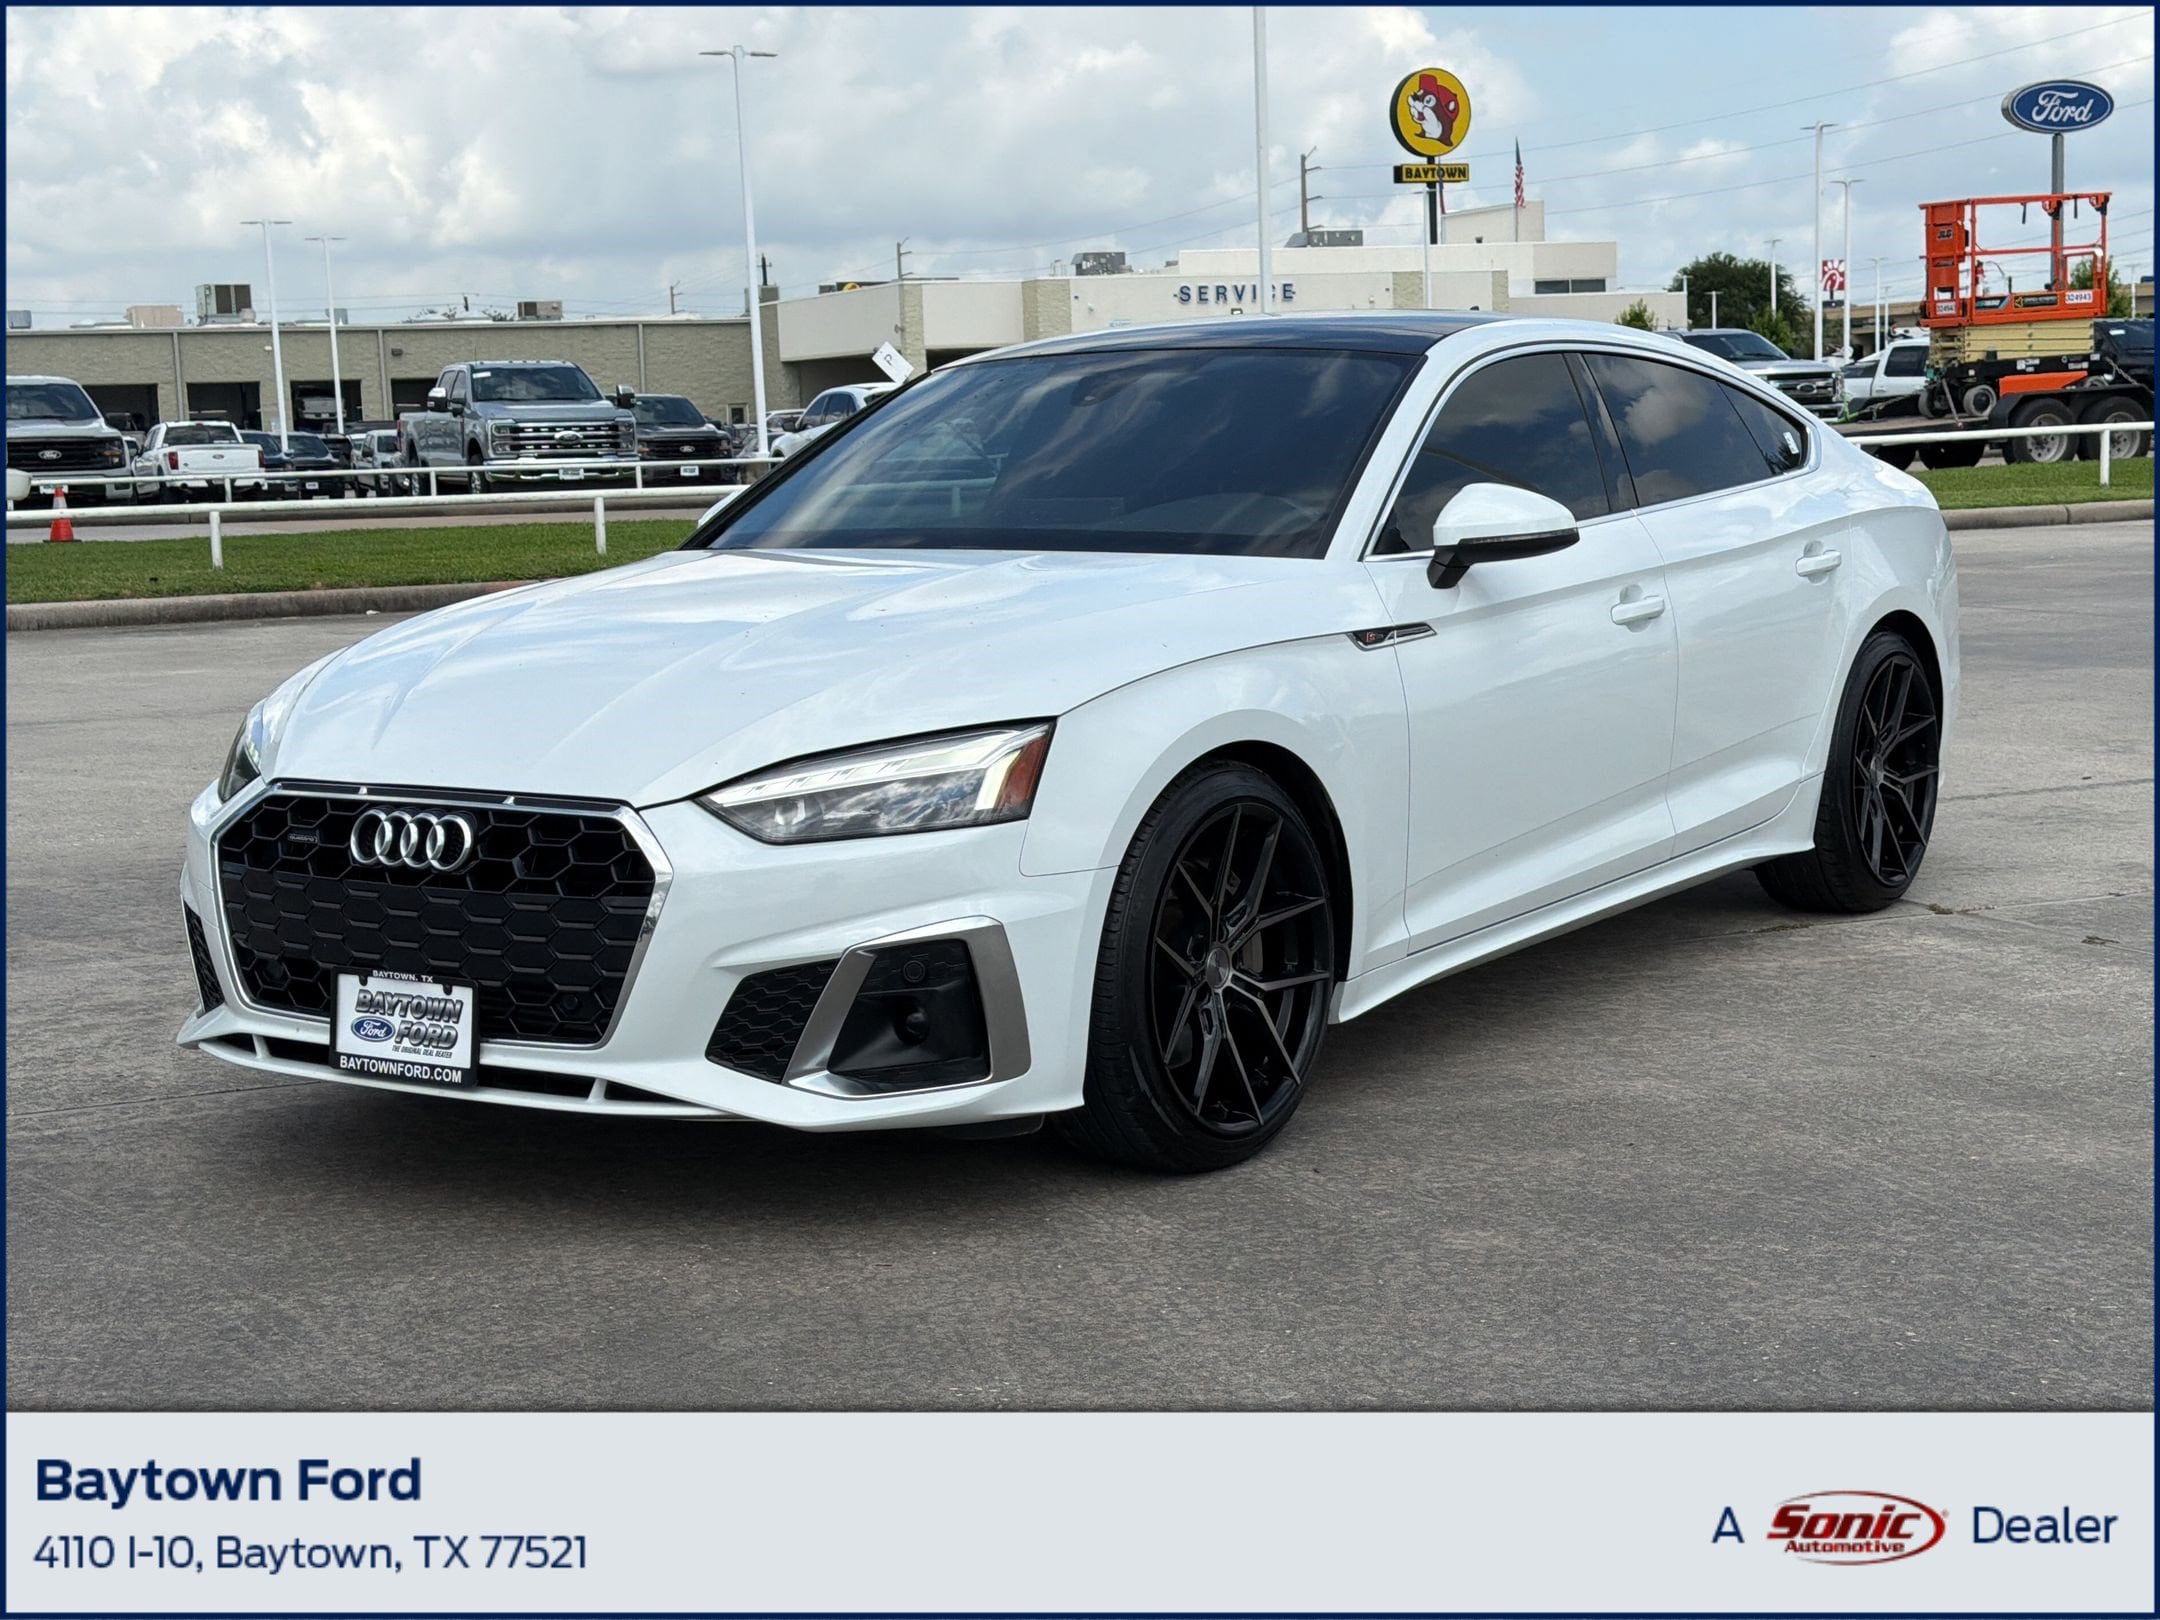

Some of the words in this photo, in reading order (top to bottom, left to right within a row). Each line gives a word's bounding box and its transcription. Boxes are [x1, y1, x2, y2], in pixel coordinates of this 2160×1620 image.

[2032, 90, 2095, 122] Ford
[1404, 167, 1468, 179] BAYTOWN
[1179, 283, 1295, 304] SERVIE
[421, 975, 433, 984] TX
[355, 989, 464, 1024] BAYTOWN
[360, 1020, 386, 1038] Ford
[394, 1020, 459, 1051] FORD
[340, 1056, 462, 1083] BAYTOWNFORD.COM
